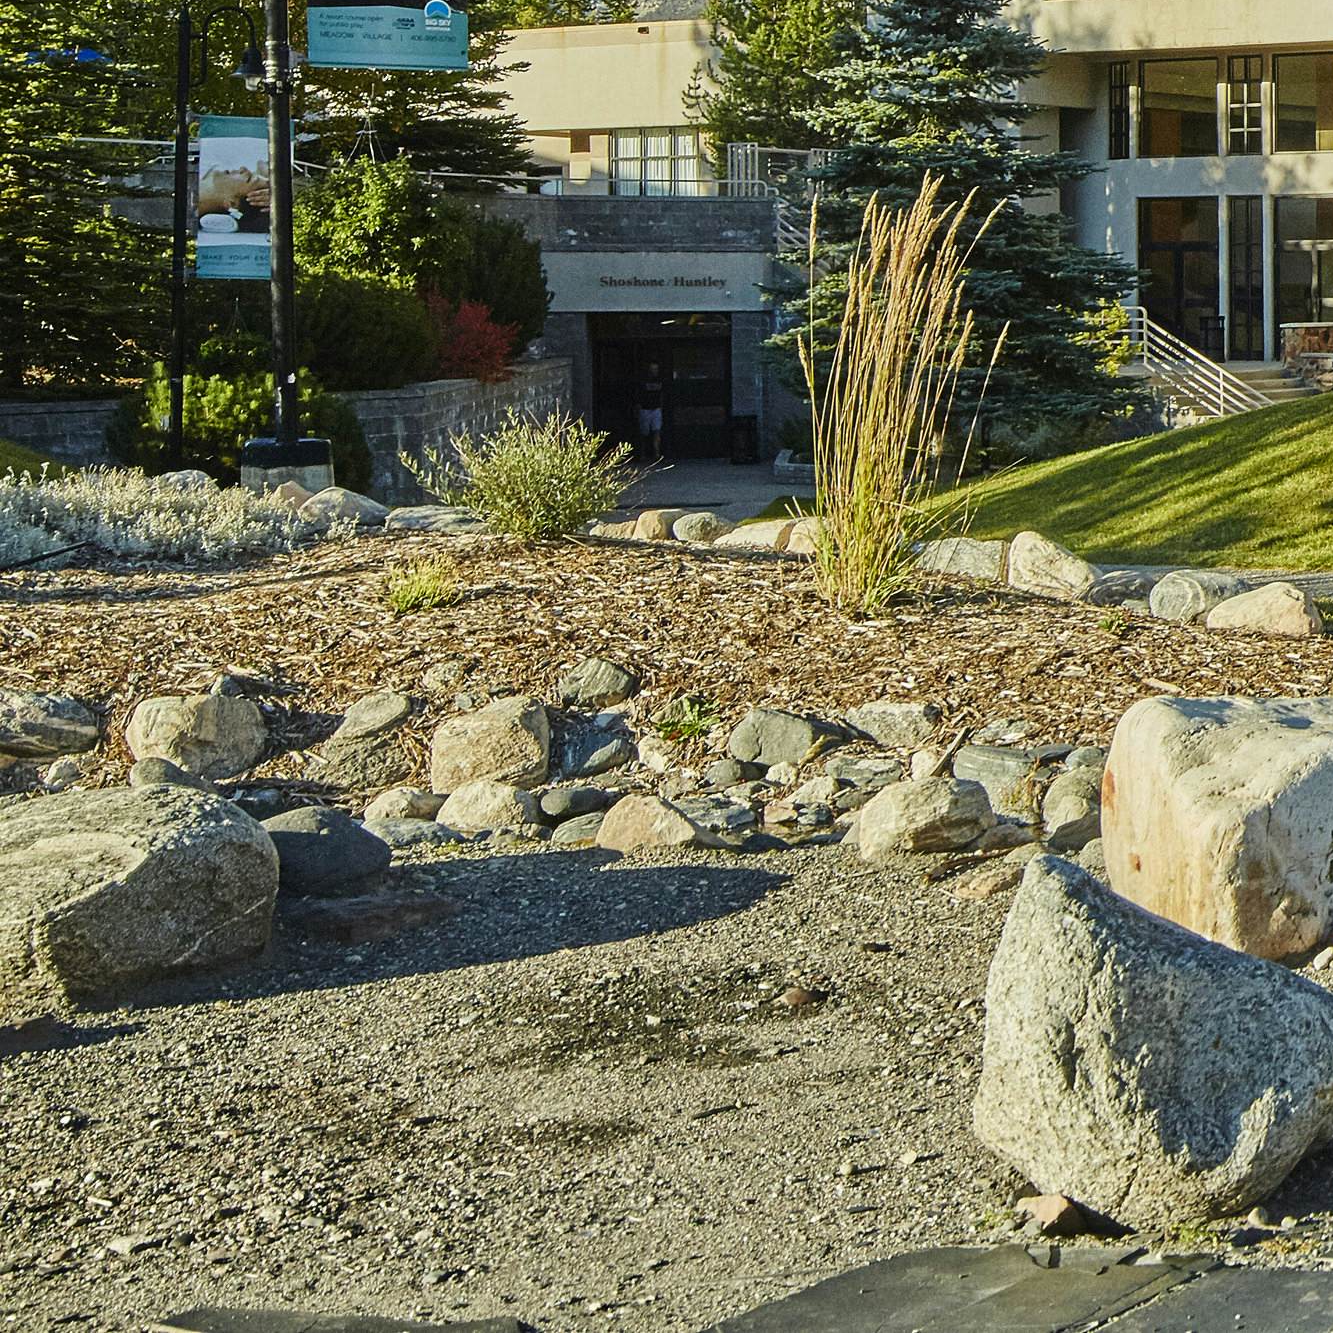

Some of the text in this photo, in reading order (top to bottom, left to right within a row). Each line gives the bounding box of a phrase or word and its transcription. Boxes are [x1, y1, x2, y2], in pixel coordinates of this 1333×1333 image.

[425, 18, 438, 26] BIG
[438, 19, 452, 27] SKY
[362, 33, 393, 41] VILLAGE
[600, 276, 665, 287] Shoshone
[673, 276, 727, 290] Huntley
